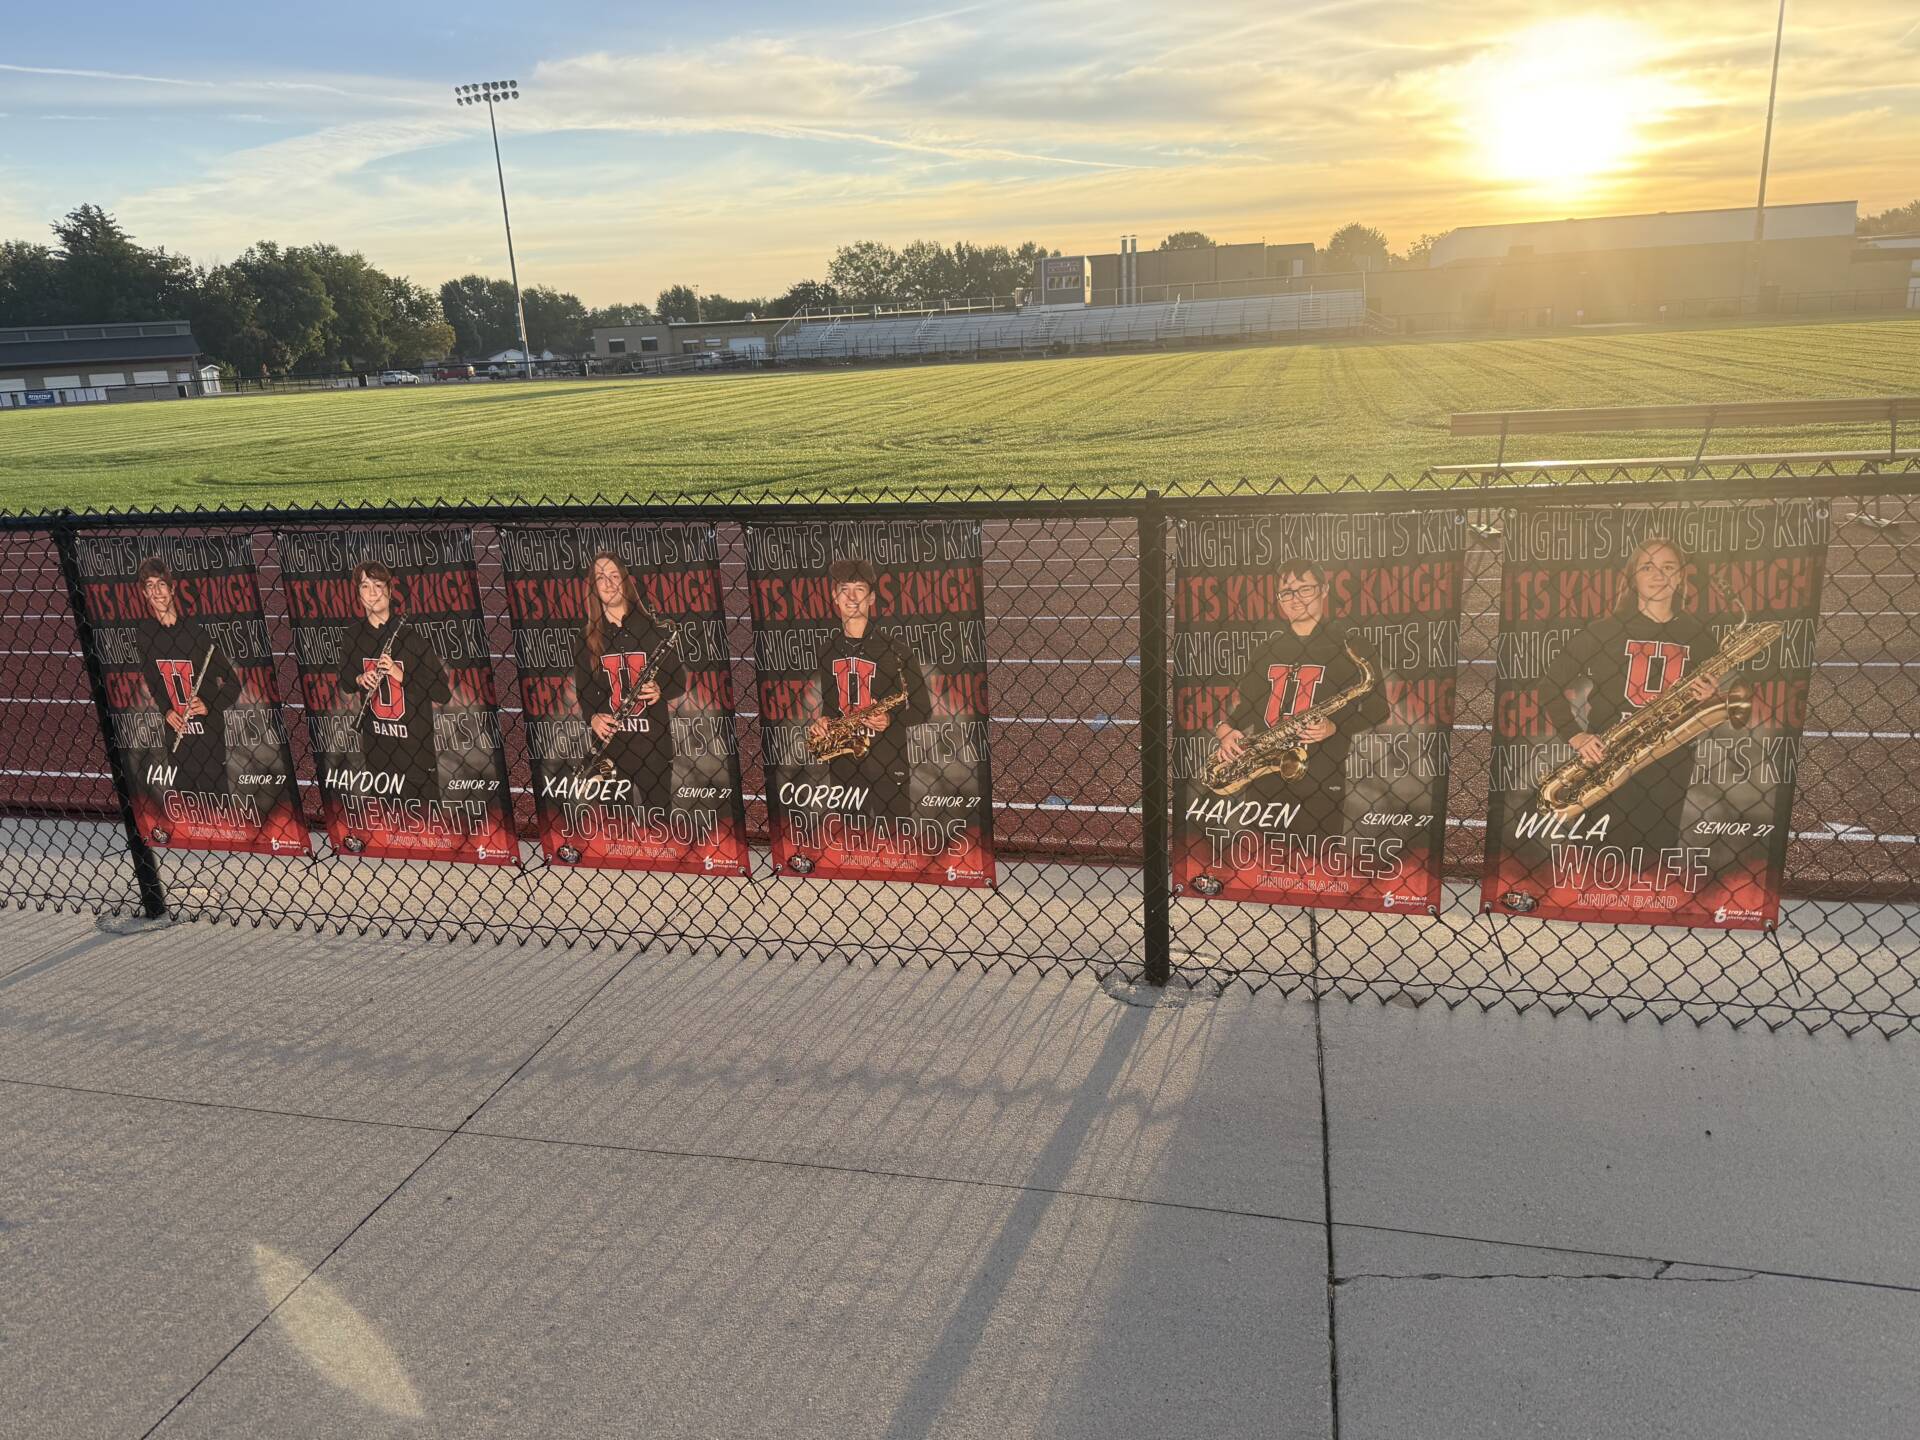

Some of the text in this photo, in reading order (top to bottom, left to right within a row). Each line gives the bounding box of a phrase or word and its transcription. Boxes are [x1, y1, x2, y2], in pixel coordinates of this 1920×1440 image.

[1624, 639, 1690, 709] U
[373, 721, 408, 739] BAND
[616, 718, 650, 733] AND
[146, 765, 178, 787] IAN
[238, 775, 286, 785] SENIOR 27
[325, 768, 406, 795] HAYDON
[448, 779, 500, 791] SENIOR 27
[542, 776, 632, 801] XANDER
[676, 787, 733, 799] SENIOR 27
[779, 782, 869, 811] CORBIN
[163, 790, 262, 828] GRIMM
[921, 795, 981, 808] SENIOR 27
[340, 793, 490, 837] HEMSATH
[561, 803, 719, 847] JOHNSON
[1186, 798, 1300, 829] HAYDEN
[1361, 812, 1434, 827] SENIOR 27
[788, 808, 970, 858] RICHARDS
[1515, 811, 1611, 842] WILLA
[1693, 821, 1775, 838] SENIOR 27
[1205, 827, 1404, 881] TOENGES
[1550, 843, 1711, 894] WOLFF
[1256, 874, 1350, 893] UNION BAND
[1577, 893, 1678, 909] UNION BAND
[1727, 909, 1744, 917] troy
